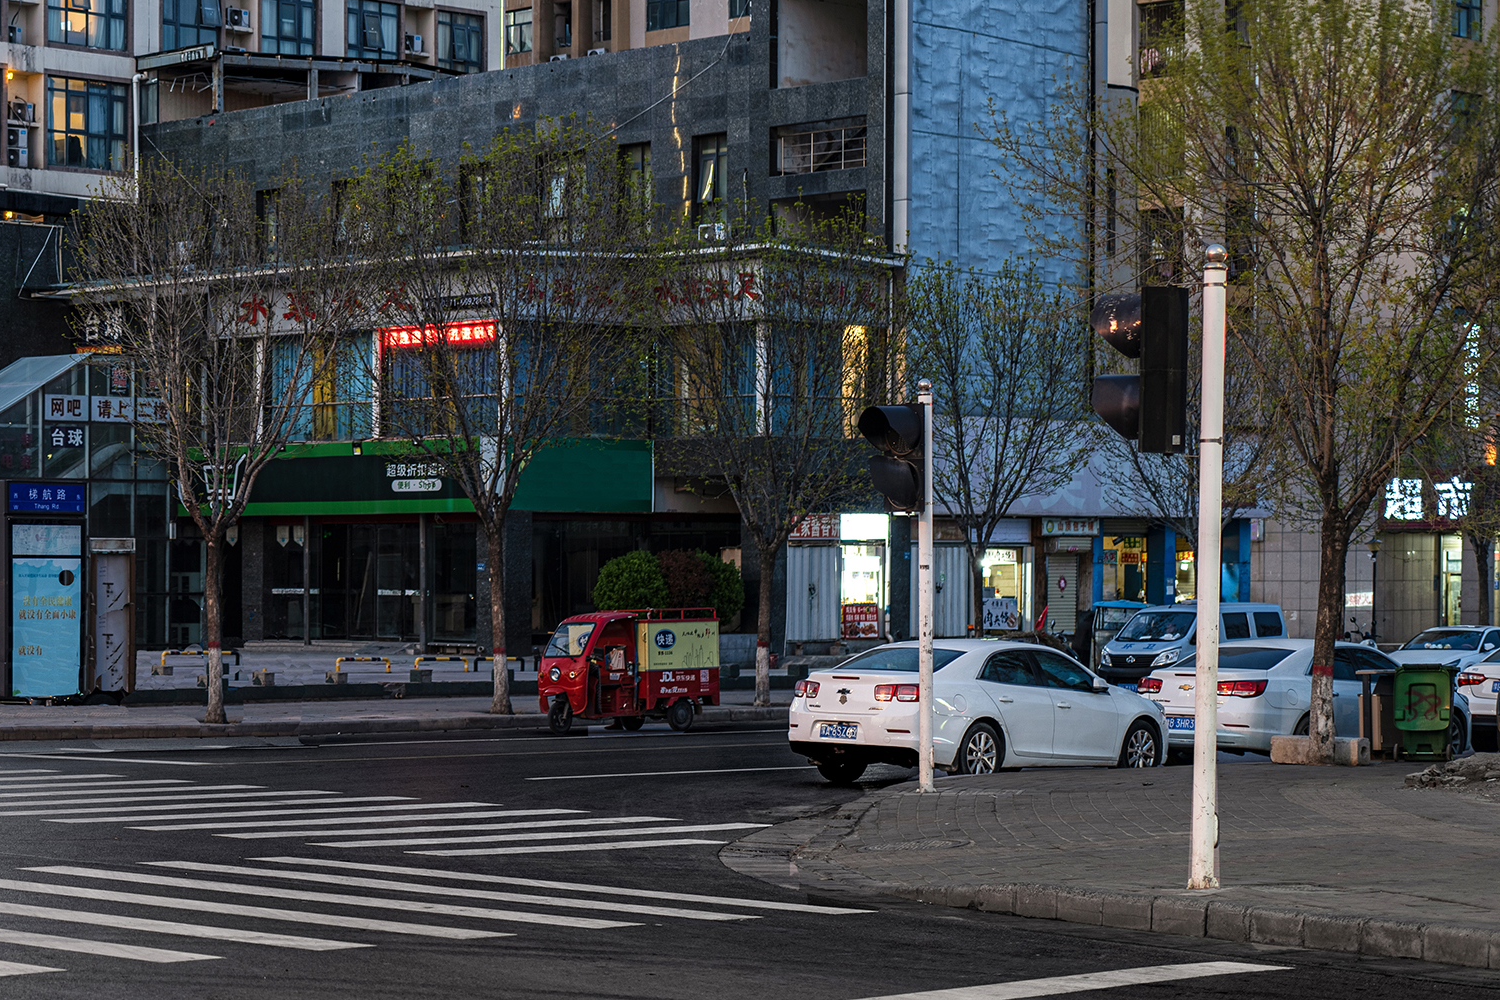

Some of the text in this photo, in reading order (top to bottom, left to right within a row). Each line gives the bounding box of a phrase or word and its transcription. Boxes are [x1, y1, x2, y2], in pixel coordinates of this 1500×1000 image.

[51, 398, 82, 417] 网吧
[51, 428, 83, 447] 台球
[28, 488, 66, 500] 梯航路
[22, 596, 73, 607] 没有全民健康
[18, 609, 77, 620] 就没有全面小康
[656, 632, 674, 646] 快递
[18, 645, 43, 656] 就没有
[660, 671, 675, 683] JDL
